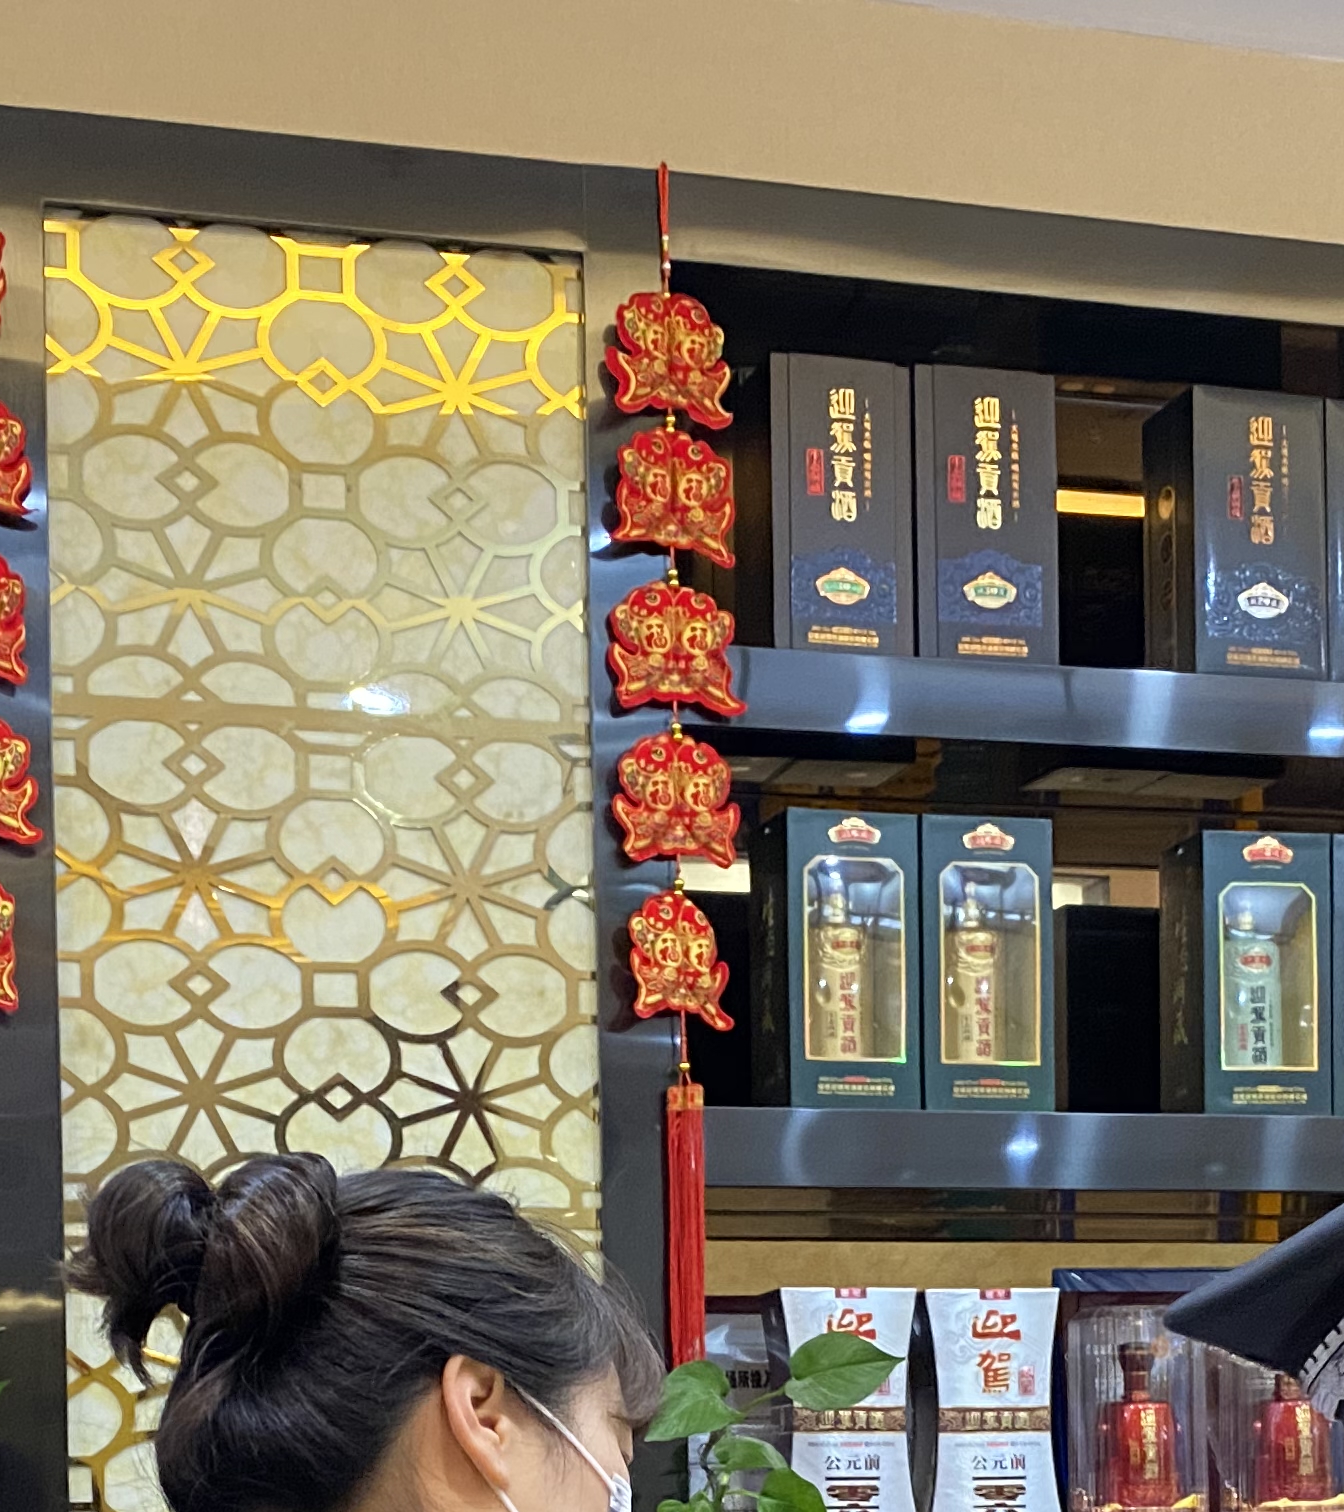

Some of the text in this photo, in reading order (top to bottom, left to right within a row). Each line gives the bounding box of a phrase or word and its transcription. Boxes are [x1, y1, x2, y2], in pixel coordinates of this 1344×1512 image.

[642, 624, 666, 649] 福
[685, 626, 710, 650] 福
[648, 778, 670, 804] 福
[688, 780, 713, 805] 福
[659, 937, 680, 961] 福
[825, 1453, 881, 1472] 公元前
[971, 1453, 1027, 1472] 公元前
